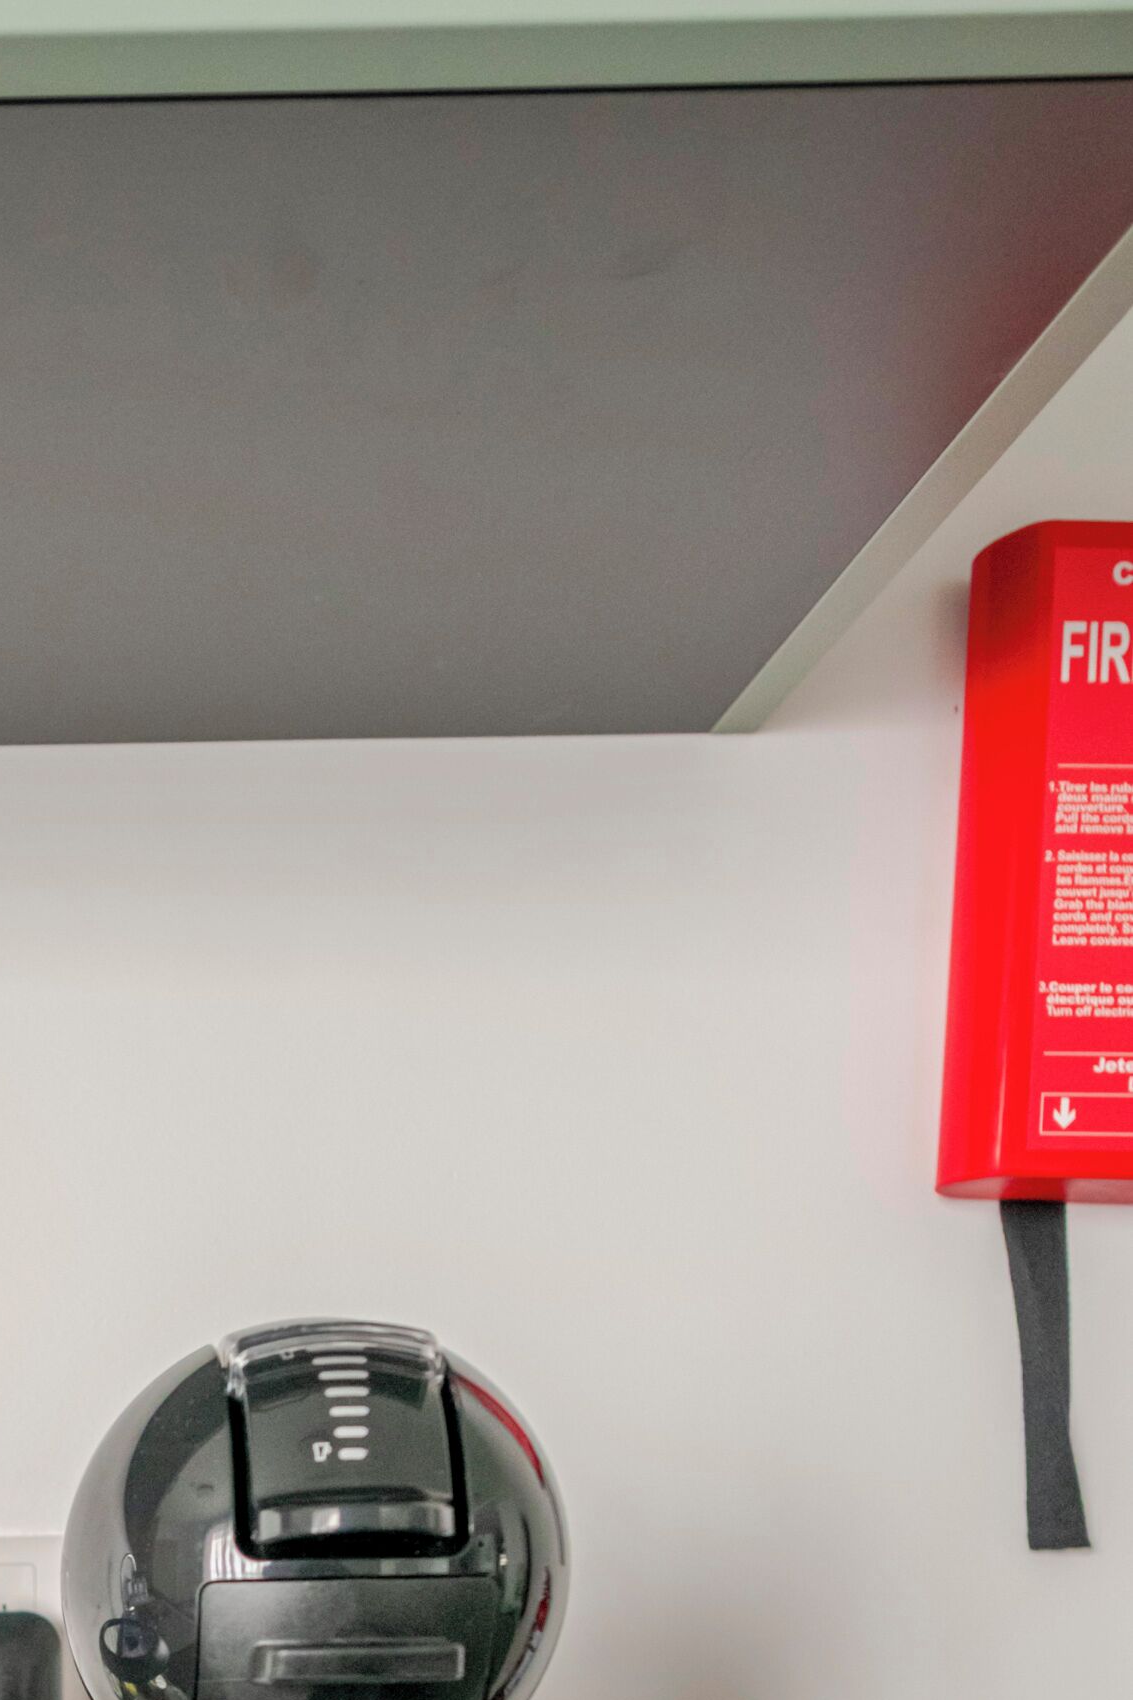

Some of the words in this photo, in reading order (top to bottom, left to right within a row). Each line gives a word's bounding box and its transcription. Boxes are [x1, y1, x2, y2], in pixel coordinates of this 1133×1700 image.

[1060, 620, 1133, 684] FIR
[1081, 813, 1100, 823] the
[1055, 823, 1078, 834] and
[1080, 824, 1124, 834] remove
[1053, 898, 1083, 910] Grab
[1086, 899, 1104, 910] the
[1090, 911, 1113, 922] and
[1052, 933, 1088, 946] Leave
[1046, 1004, 1073, 1017] Turn
[1074, 1005, 1093, 1017] off
